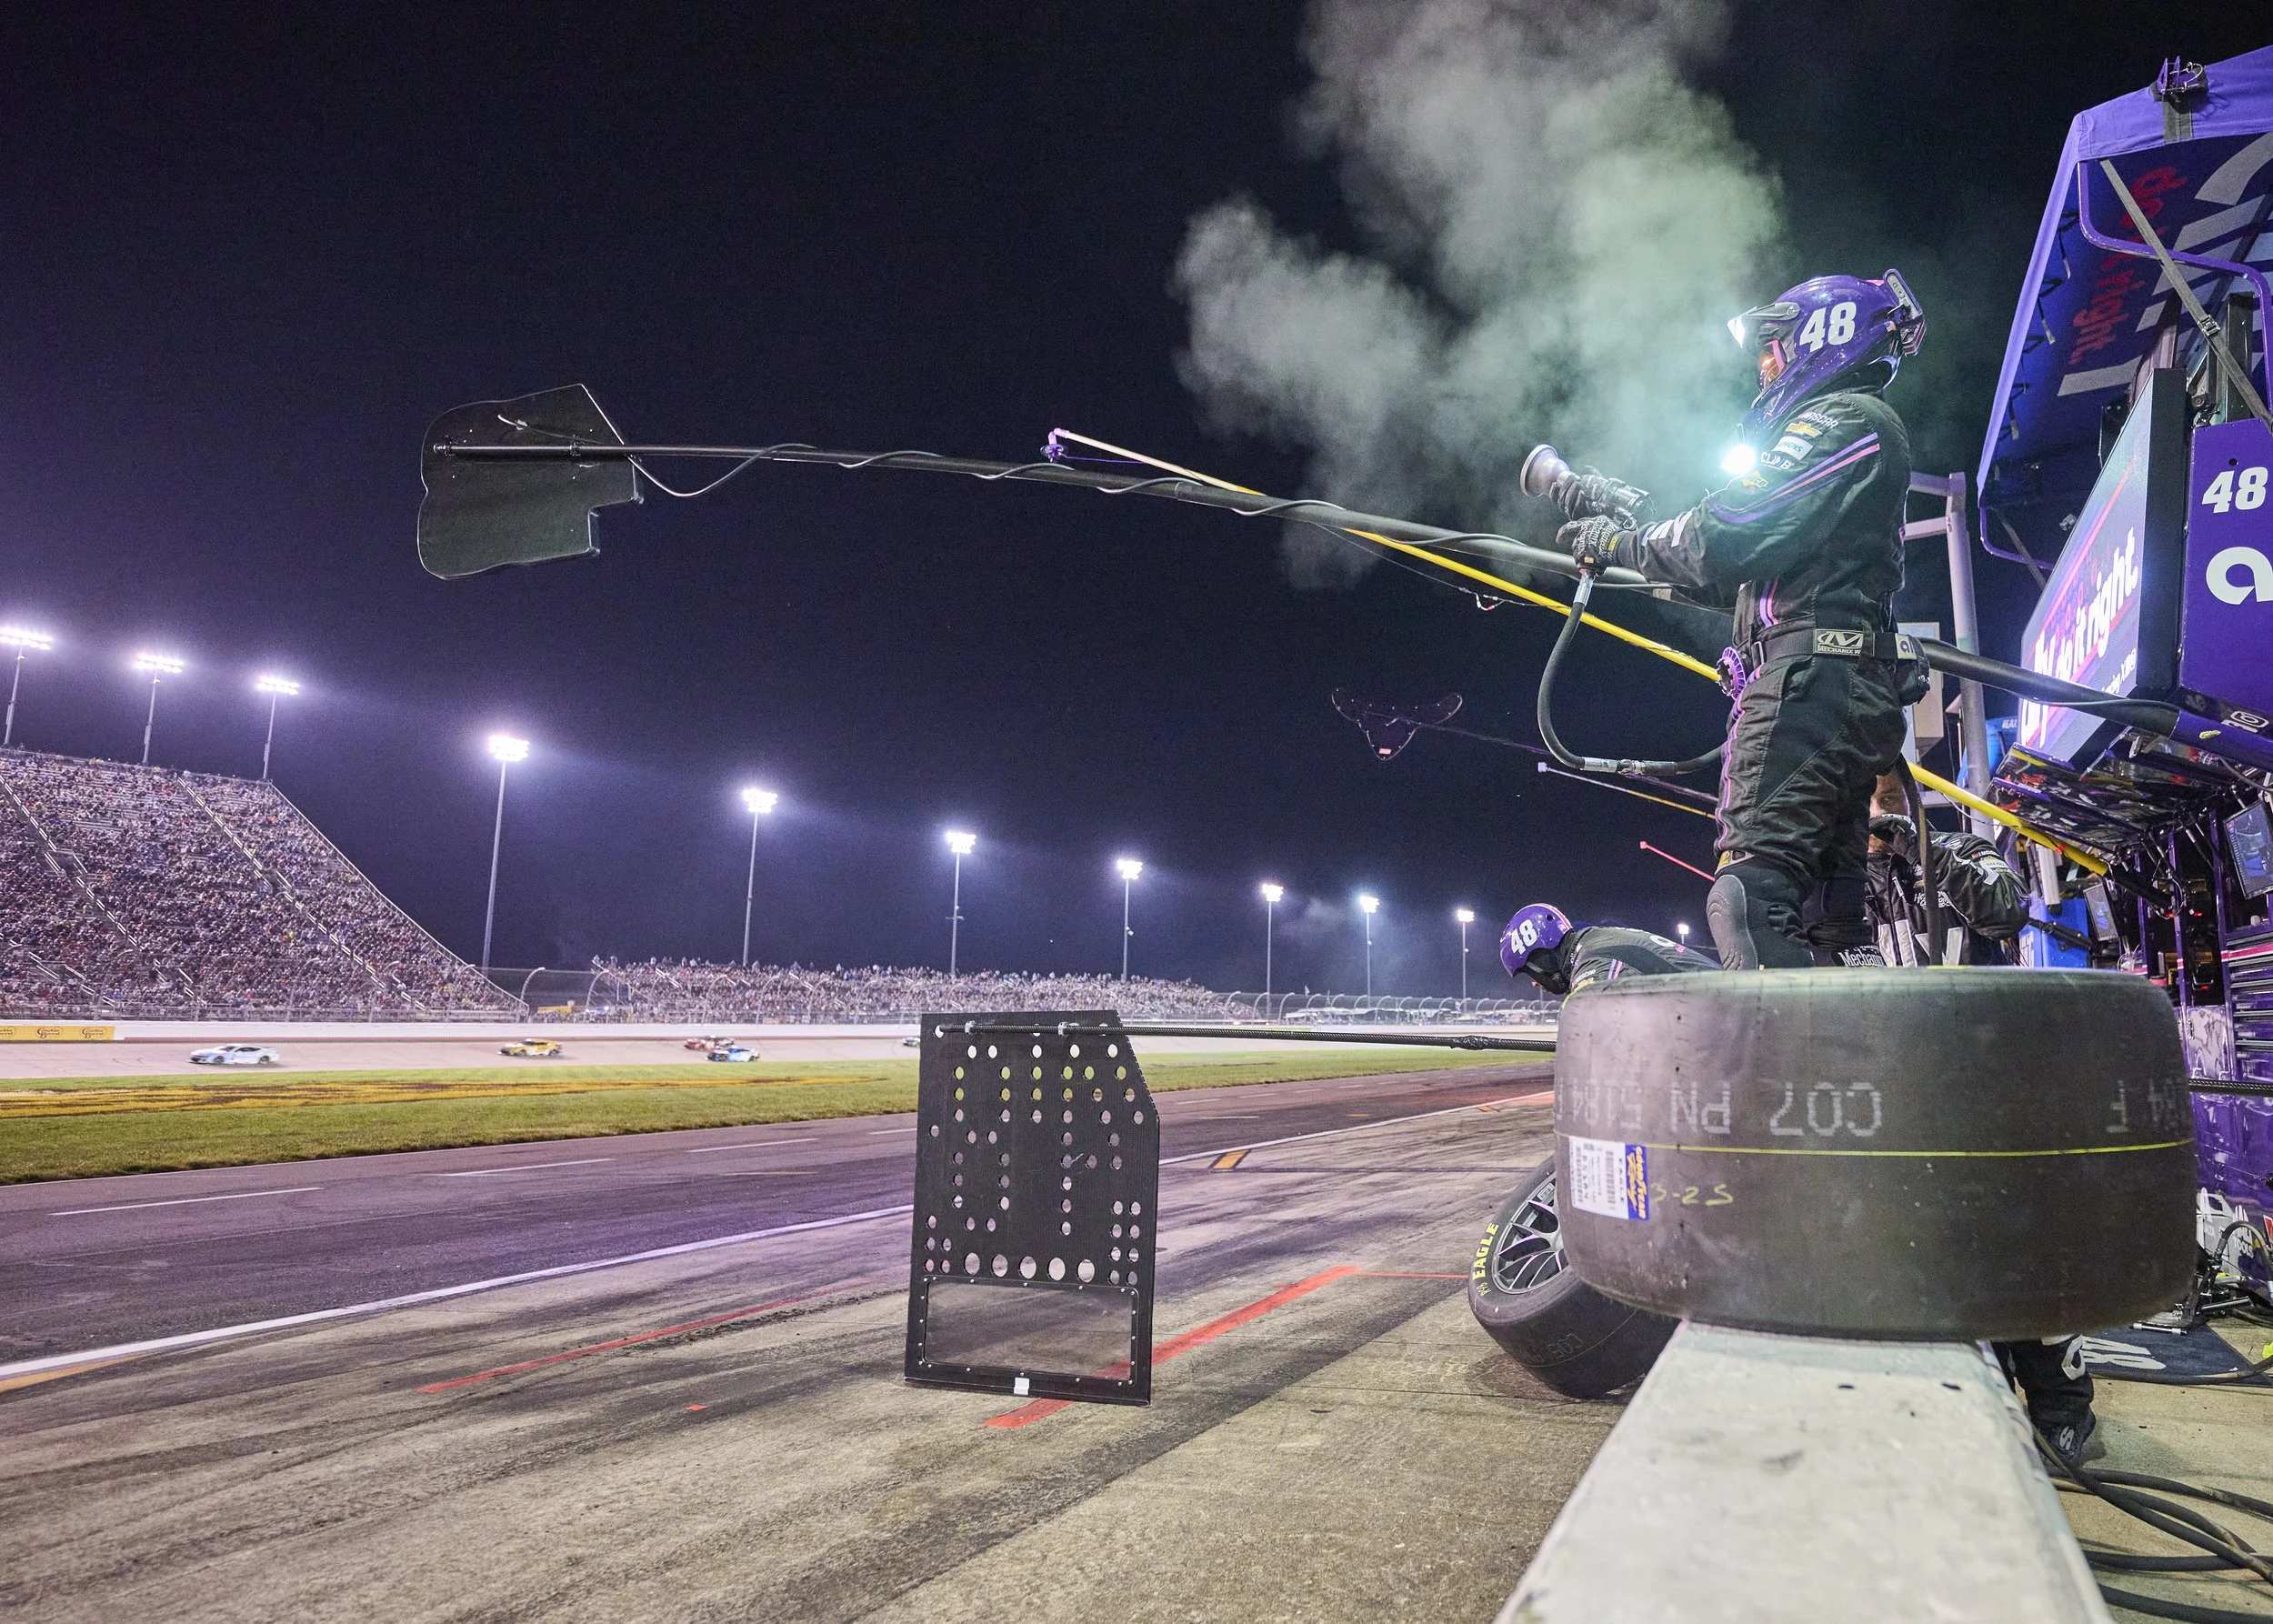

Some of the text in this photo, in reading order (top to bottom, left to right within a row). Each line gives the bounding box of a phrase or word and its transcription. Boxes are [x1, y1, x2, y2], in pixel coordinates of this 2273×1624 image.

[1799, 301, 1857, 353] 48
[2202, 466, 2268, 514] 48
[1510, 919, 1537, 956] 48
[1670, 1080, 1731, 1135] PN
[1472, 1222, 1499, 1280] EAGLE
